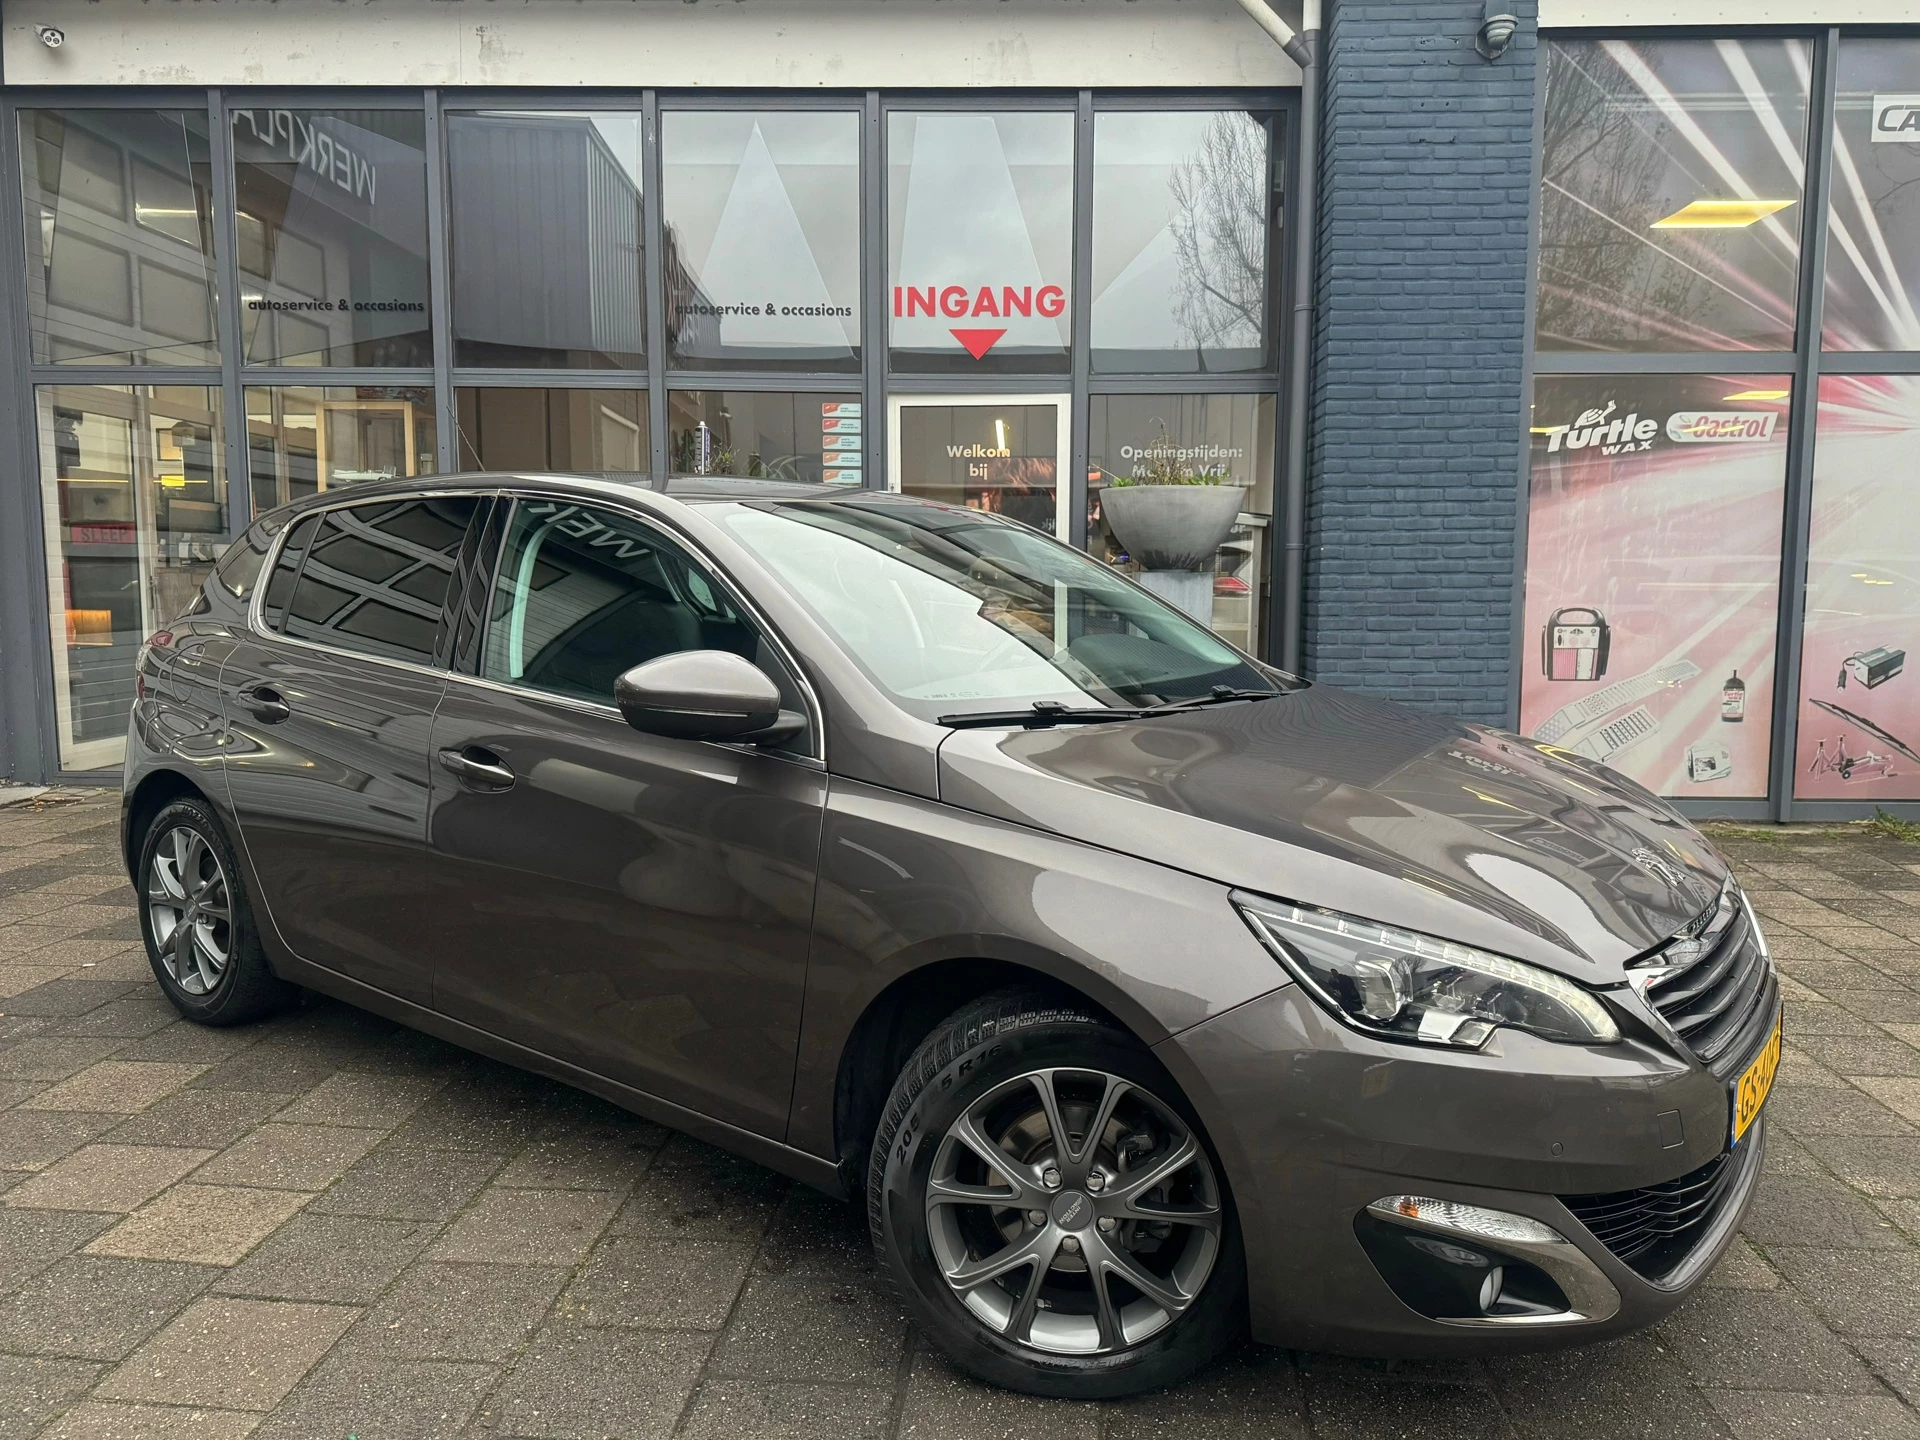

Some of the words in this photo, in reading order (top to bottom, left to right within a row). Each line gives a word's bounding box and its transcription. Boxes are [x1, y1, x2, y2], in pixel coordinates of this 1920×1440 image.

[248, 298, 333, 311] autoservice
[337, 298, 350, 311] &
[353, 299, 425, 312] occasions
[674, 302, 760, 316] autoservice
[765, 303, 777, 316] &
[781, 302, 852, 317] occasions
[894, 285, 1066, 318] INGANG
[1545, 412, 1659, 453] Turtle
[1692, 415, 1769, 438] Castrol
[946, 443, 1011, 458] Welkom
[1120, 444, 1243, 461] Openingstijden:
[969, 463, 988, 480] bij
[958, 1044, 1004, 1079] R16
[1066, 1206, 1082, 1223] INTER
